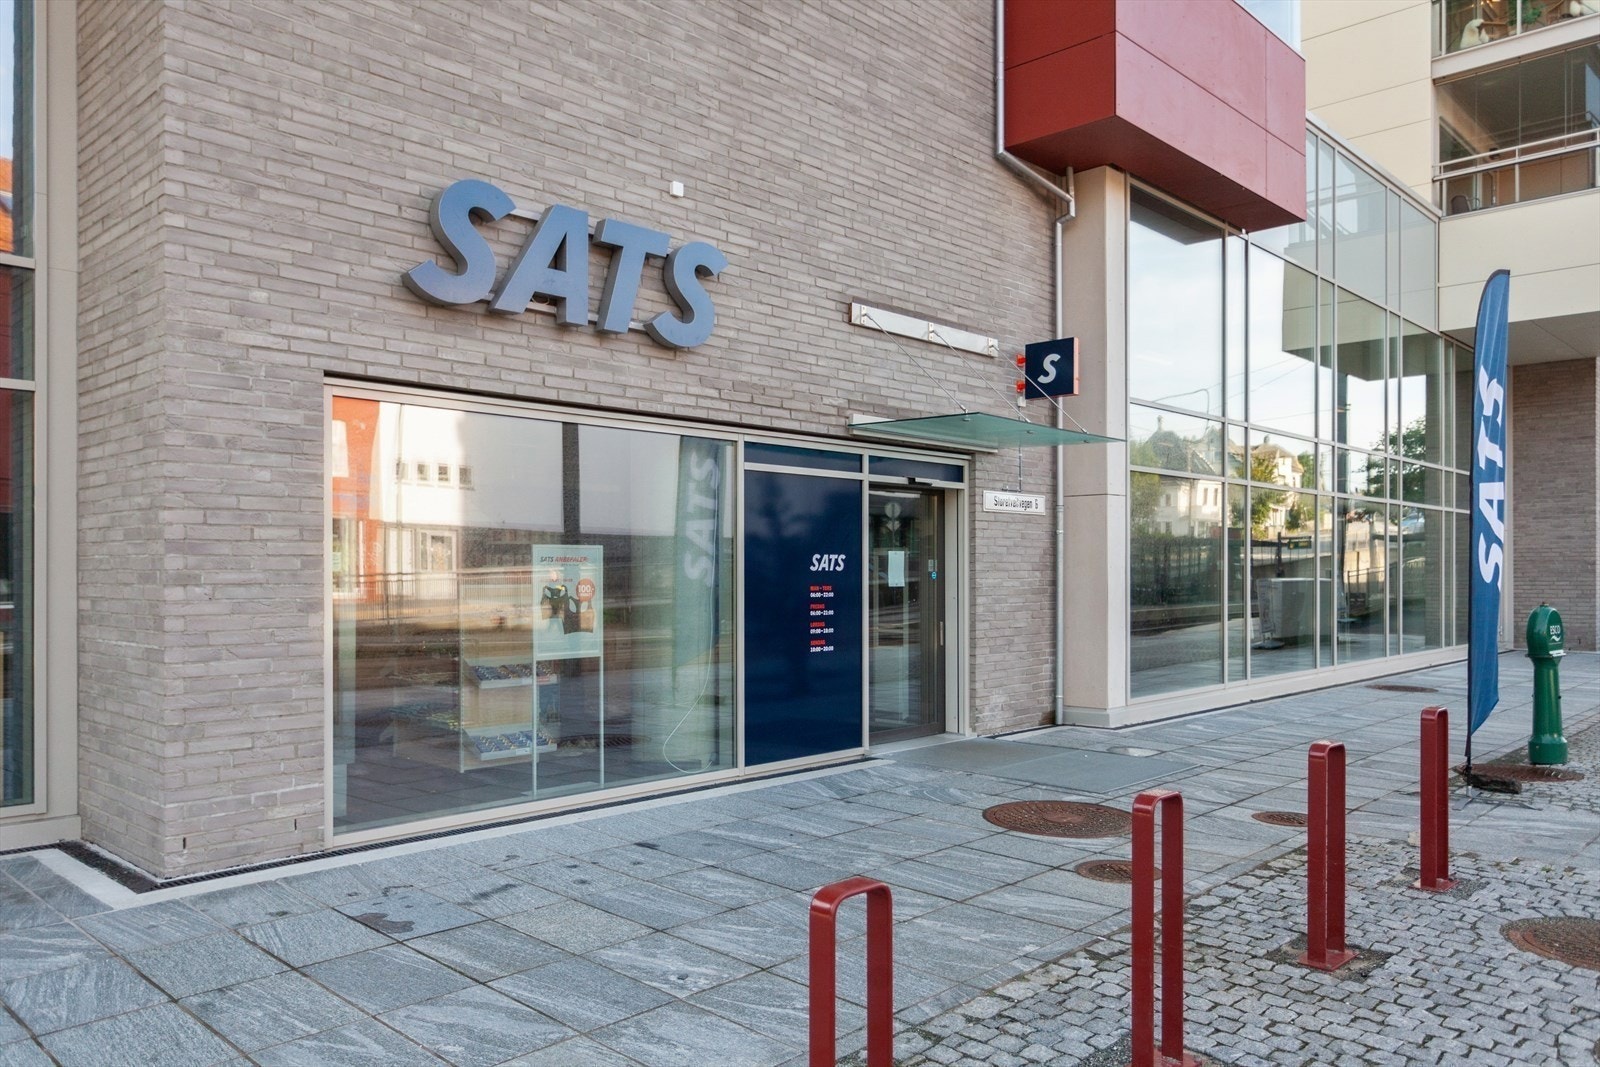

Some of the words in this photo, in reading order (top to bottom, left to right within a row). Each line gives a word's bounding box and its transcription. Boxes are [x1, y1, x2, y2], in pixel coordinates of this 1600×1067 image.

[401, 179, 729, 348] SATS
[1037, 353, 1061, 384] S
[684, 451, 720, 588] SATS
[1478, 365, 1504, 592] SATS
[809, 553, 846, 572] SATS
